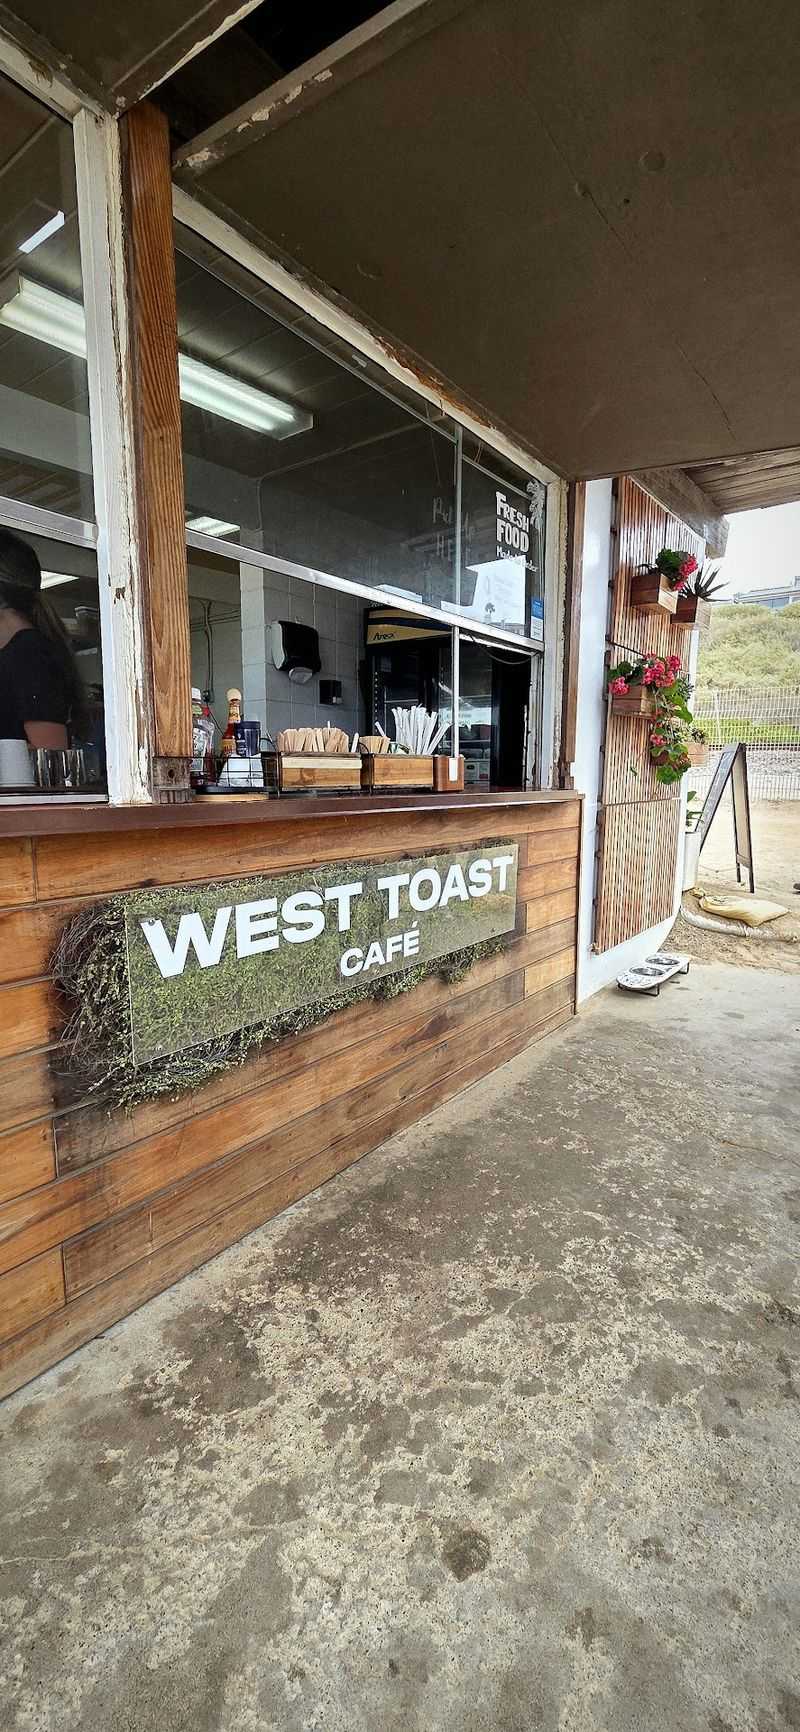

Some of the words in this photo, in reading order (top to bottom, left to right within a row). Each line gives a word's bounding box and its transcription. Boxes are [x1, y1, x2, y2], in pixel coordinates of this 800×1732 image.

[496, 491, 529, 532] FRESH
[496, 518, 529, 552] FOOD
[140, 882, 362, 978] WEST
[378, 855, 514, 920] TOAST
[340, 920, 420, 977] CAFÉ
